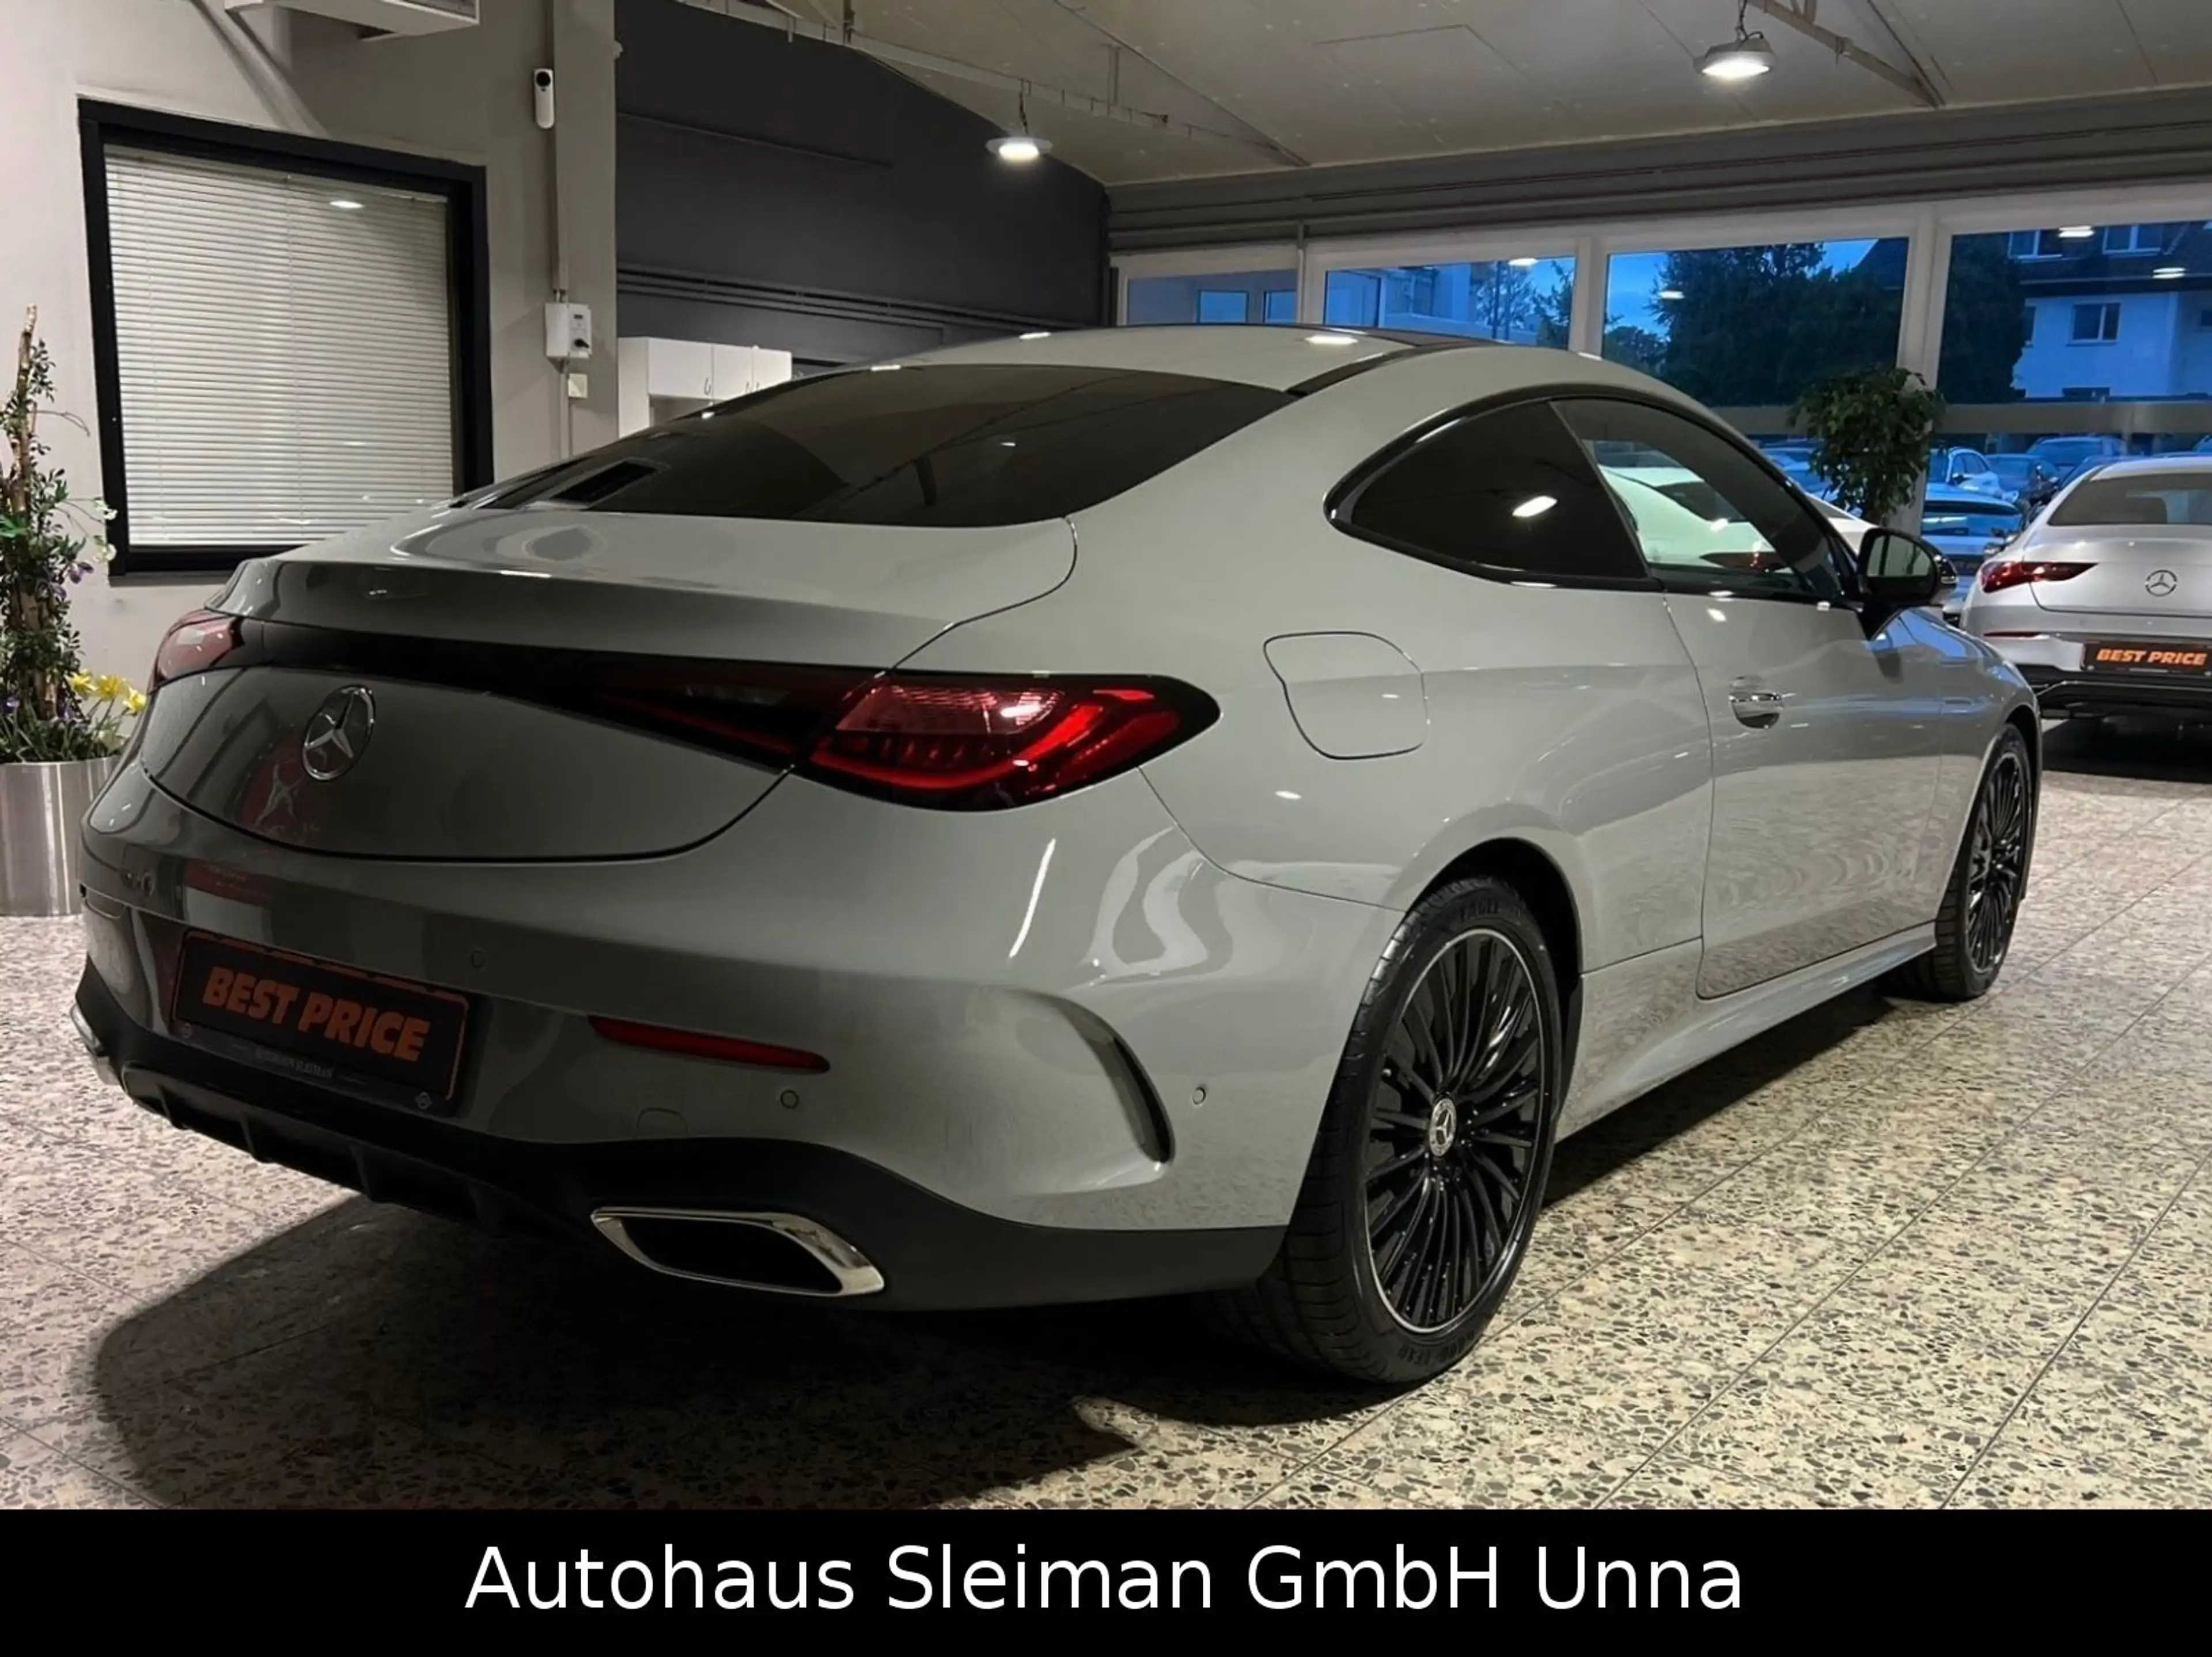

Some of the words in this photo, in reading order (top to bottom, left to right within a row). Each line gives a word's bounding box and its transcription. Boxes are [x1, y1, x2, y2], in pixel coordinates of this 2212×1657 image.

[2097, 649, 2146, 663] BEST
[2147, 650, 2207, 666] PRICE
[203, 966, 300, 1024] BEST
[298, 992, 430, 1061] PRICE
